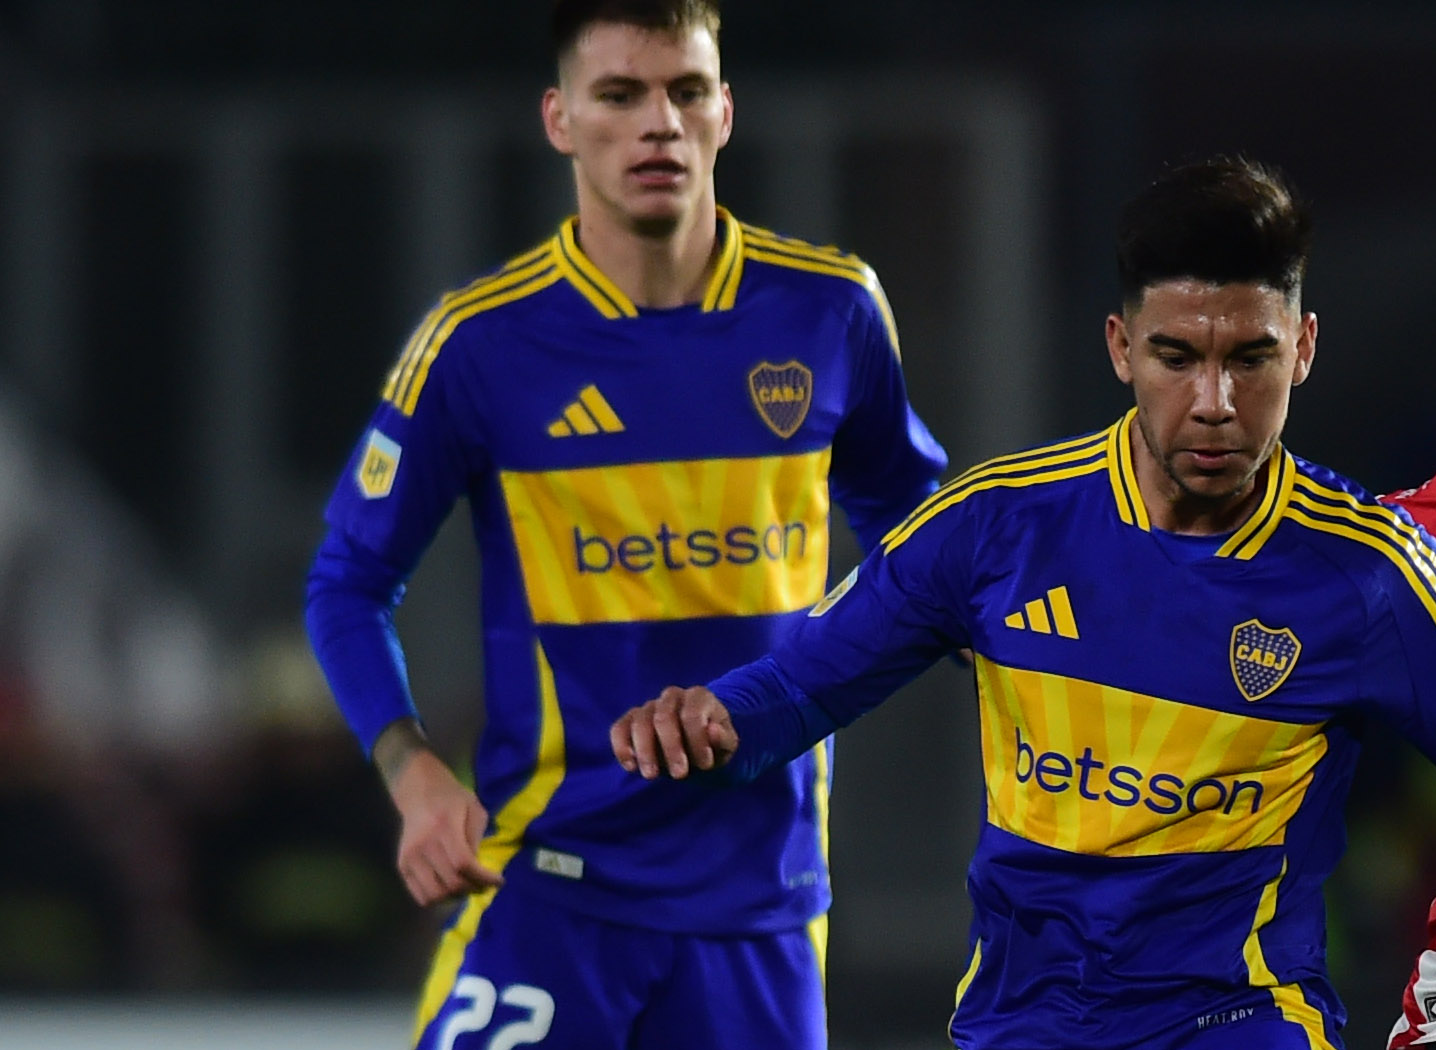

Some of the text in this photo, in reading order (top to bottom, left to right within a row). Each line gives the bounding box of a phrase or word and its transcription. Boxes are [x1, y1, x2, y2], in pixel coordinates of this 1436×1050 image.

[573, 522, 806, 574] betsson
[1236, 645, 1288, 670] CABJ
[1015, 726, 1264, 815] betsson
